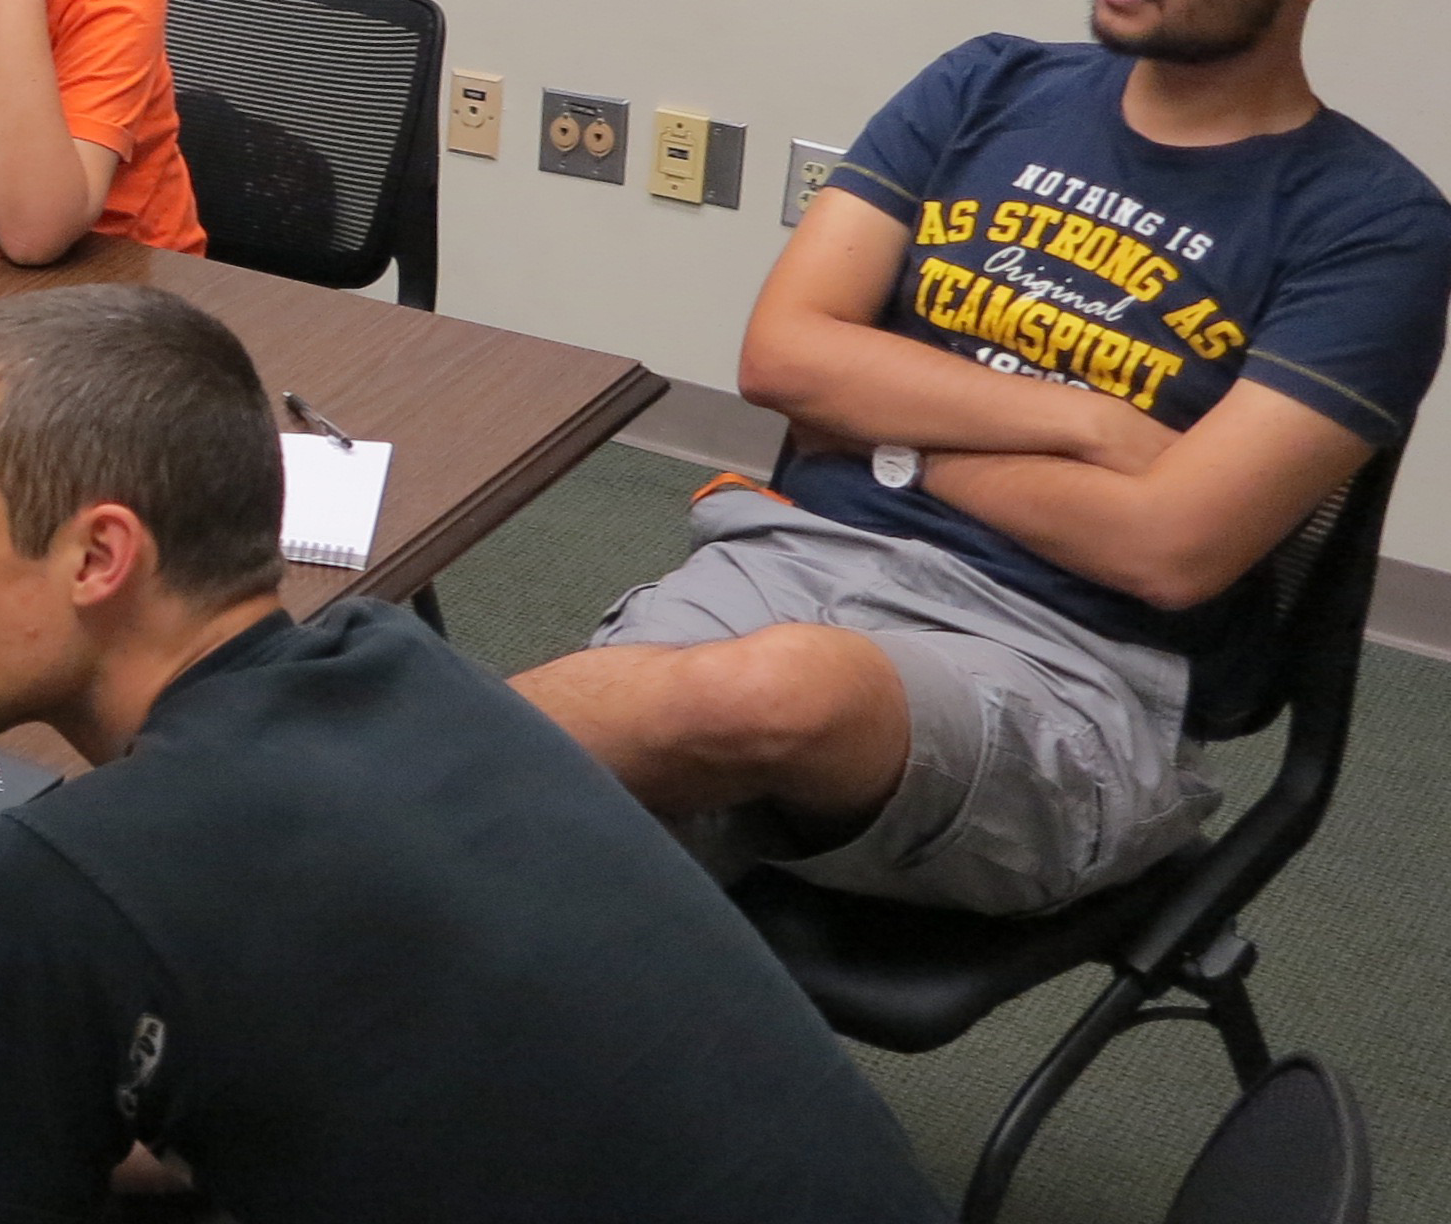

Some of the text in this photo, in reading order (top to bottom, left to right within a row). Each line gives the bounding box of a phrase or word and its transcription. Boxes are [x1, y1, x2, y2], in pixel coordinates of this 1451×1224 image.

[1011, 163, 1215, 262] NOTHING IS
[913, 257, 1186, 411] TEAMSPIRIT
[915, 199, 1247, 360] AS STRONG AS
[982, 245, 1135, 323] Original
